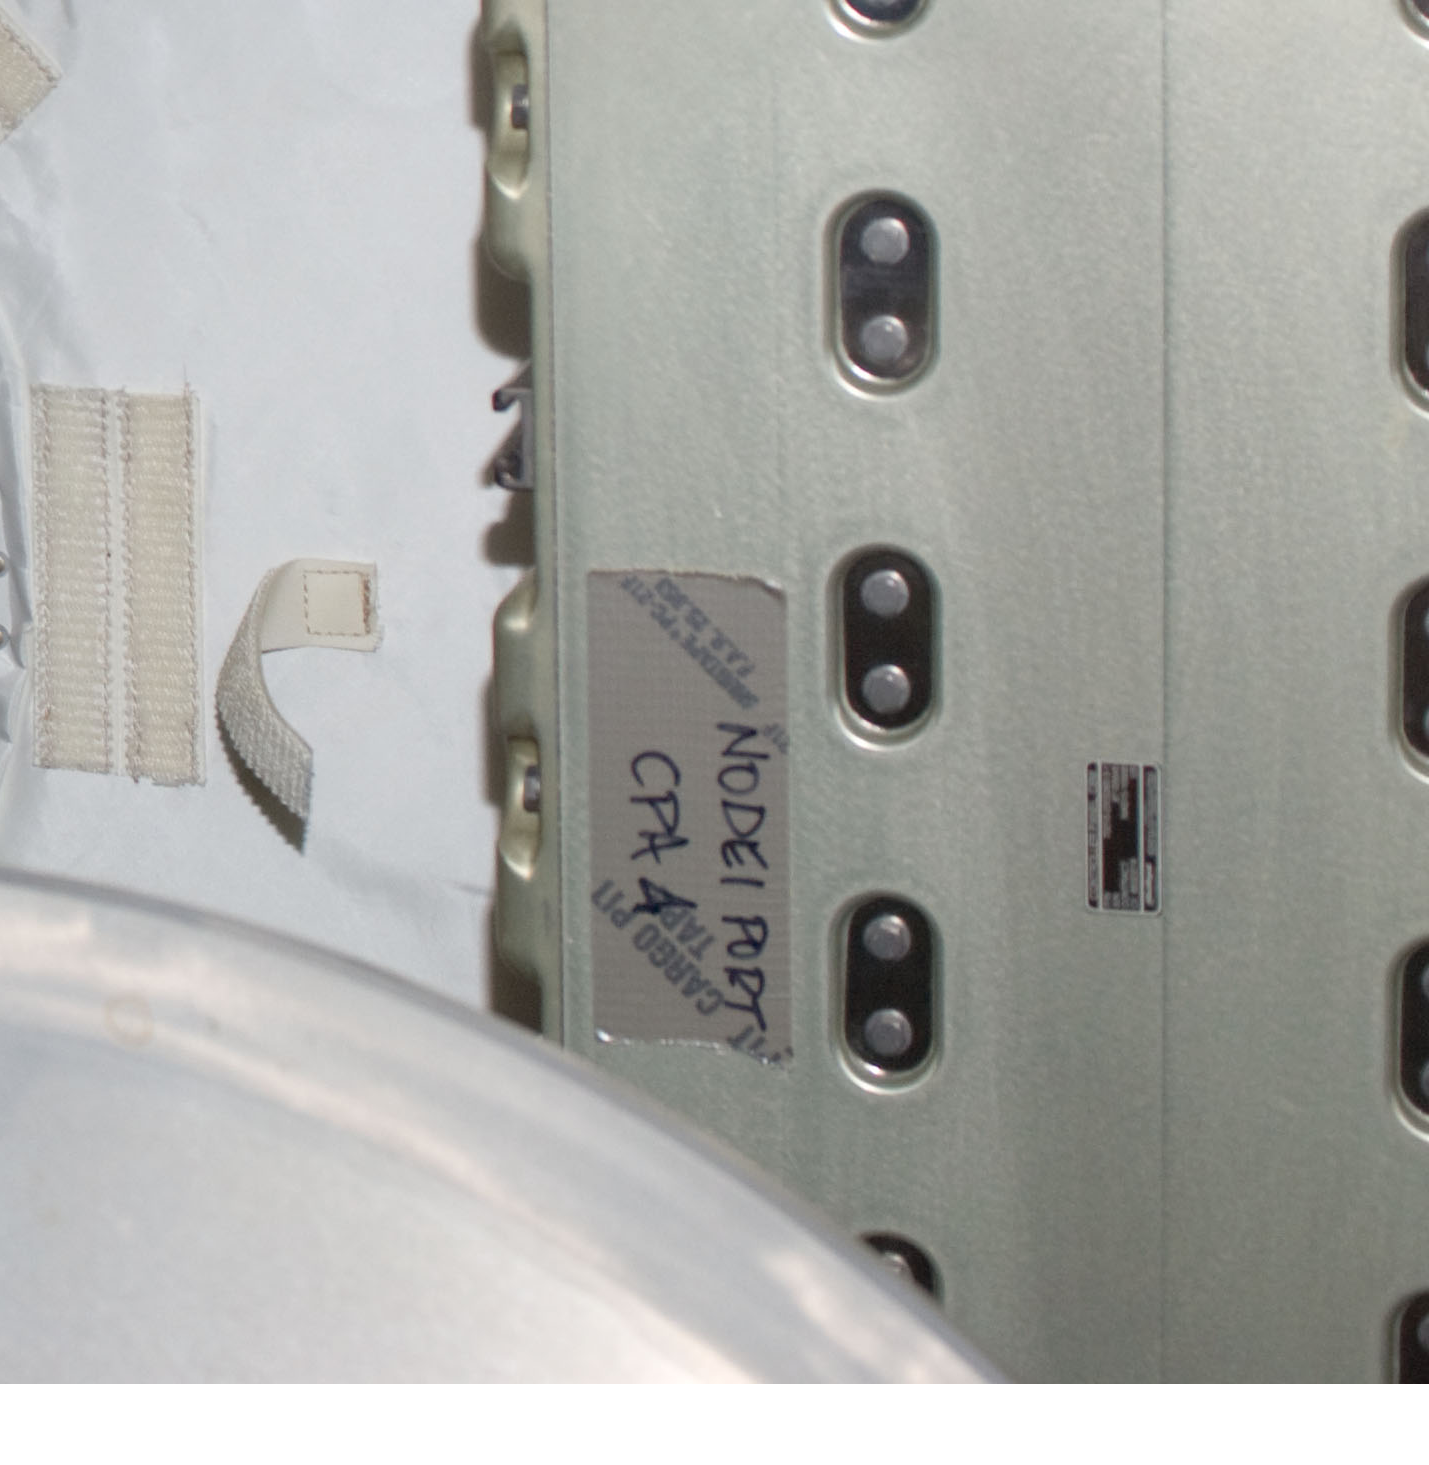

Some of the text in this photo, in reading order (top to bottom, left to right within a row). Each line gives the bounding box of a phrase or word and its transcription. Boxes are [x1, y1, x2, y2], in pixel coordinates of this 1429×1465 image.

[630, 749, 697, 915] CPA 4
[717, 721, 769, 1031] NODE1 PORT
[633, 923, 724, 1016] CARGO
[660, 907, 716, 962] TAP
